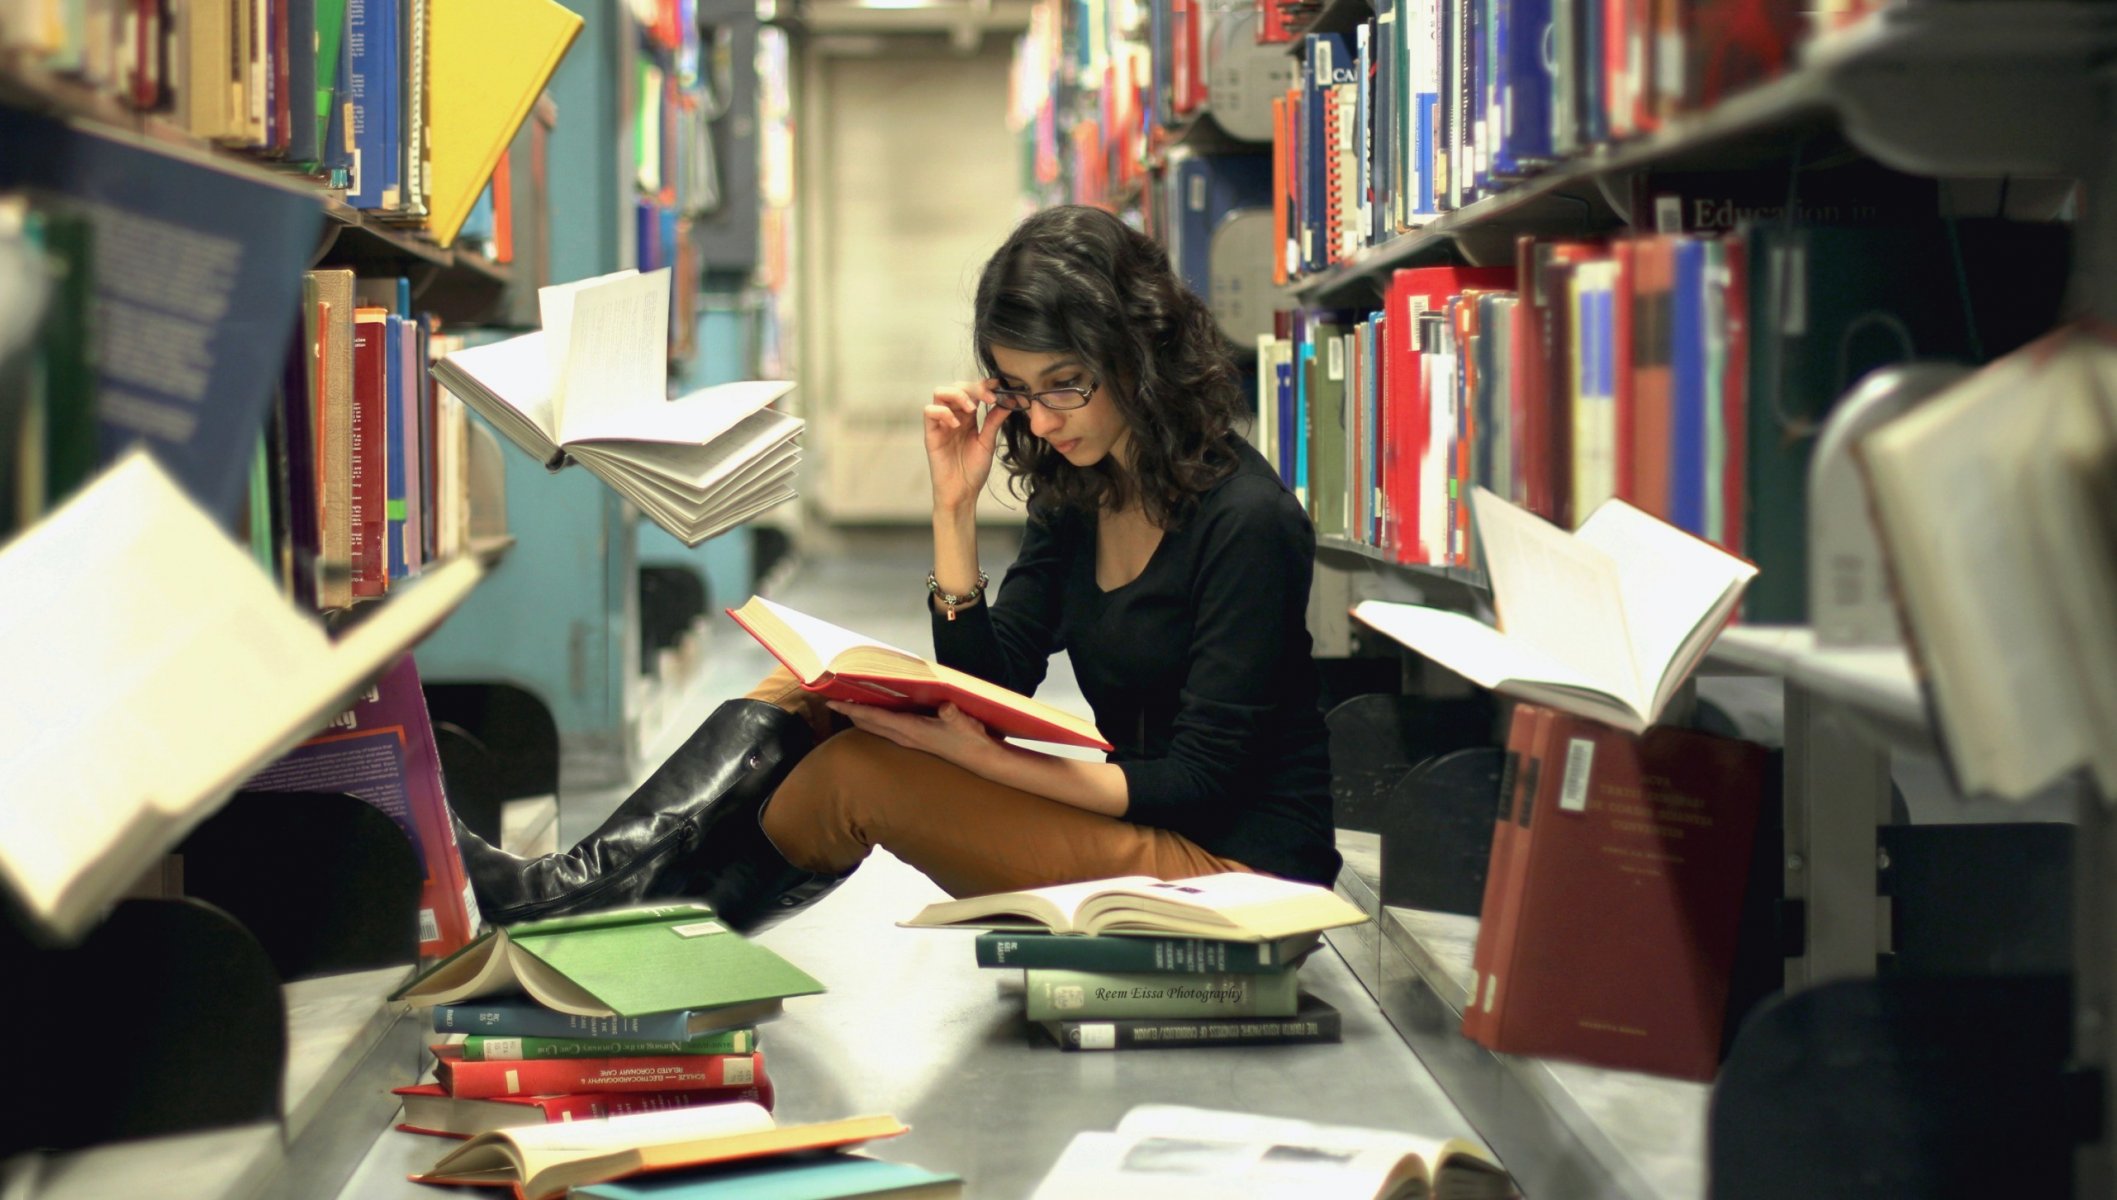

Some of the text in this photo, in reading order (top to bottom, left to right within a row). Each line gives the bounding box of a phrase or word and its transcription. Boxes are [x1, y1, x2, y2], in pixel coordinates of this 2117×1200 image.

[561, 1043, 580, 1054] Care
[584, 1042, 620, 1053] Coronary
[646, 1041, 680, 1051] Nursing
[600, 1069, 617, 1077] CARE
[620, 1068, 655, 1076] CORONARY
[679, 1073, 705, 1081] SCHULZE
[588, 1075, 663, 1085] ELECTROCARDIOGRAPHY
